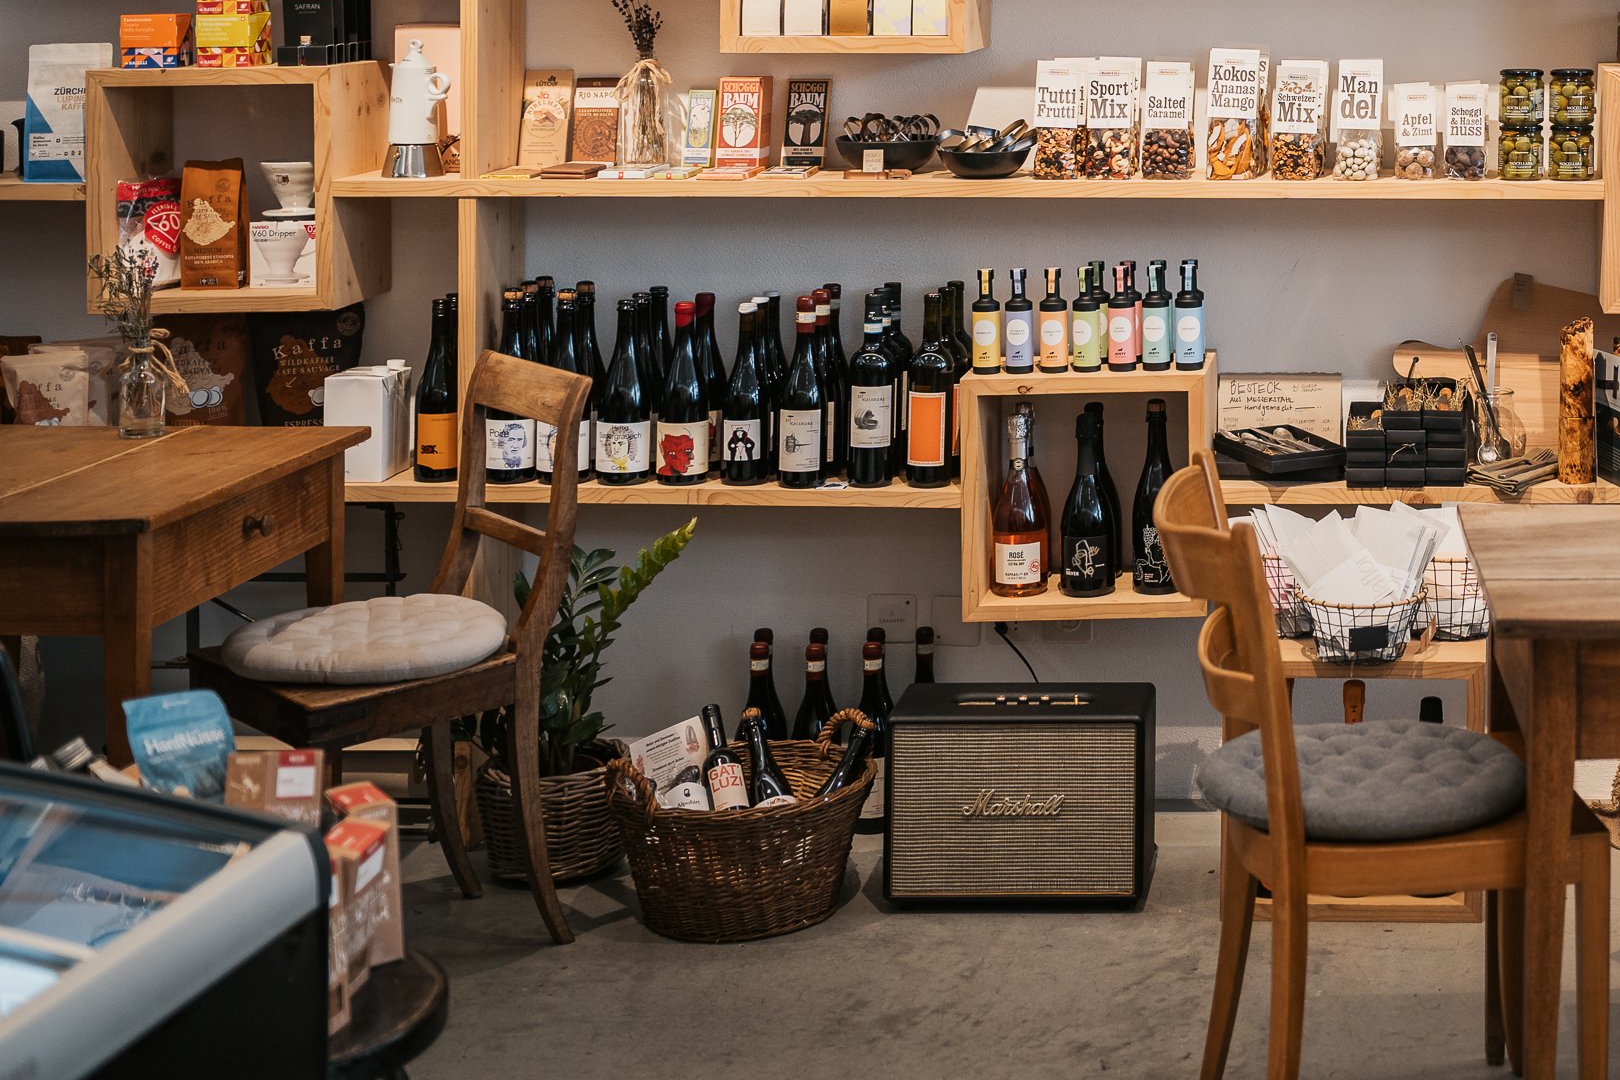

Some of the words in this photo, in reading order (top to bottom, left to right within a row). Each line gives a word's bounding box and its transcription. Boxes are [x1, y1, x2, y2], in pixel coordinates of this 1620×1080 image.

[1212, 64, 1256, 82] Kokos
[723, 82, 760, 93] SCHOGGI
[790, 82, 826, 93] SCHOGGI
[1090, 80, 1129, 97] Sport
[1211, 81, 1256, 95] Ananas
[1341, 75, 1379, 94] Man
[578, 91, 591, 100] RIO
[690, 98, 713, 107] BAUM
[722, 93, 759, 109] BAUM
[789, 93, 825, 109] BAUM
[1038, 87, 1076, 104] Tutti
[1148, 96, 1186, 109] Salted
[1211, 94, 1255, 112] Mango
[1277, 92, 1316, 103] Schweizer
[1037, 104, 1076, 119] Frutti
[1090, 99, 1128, 119] Mix
[1147, 109, 1186, 119] Caramel
[1277, 102, 1315, 123] Mix
[1340, 93, 1377, 120] del
[1451, 106, 1482, 119] Schoggi
[1402, 113, 1432, 126] Apfel
[1450, 117, 1459, 125] &
[1459, 117, 1482, 126] Hasel
[1402, 127, 1411, 136] &
[1411, 127, 1433, 137] Zimt
[1450, 125, 1482, 136] nuss
[268, 229, 297, 239] Dripper
[271, 337, 343, 361] Kaffa
[1230, 380, 1282, 395] BESTECK
[1008, 550, 1024, 559] ROSÉ
[708, 764, 740, 781] GAT'
[711, 775, 744, 793] LUZI
[961, 788, 1065, 818] Marshall
